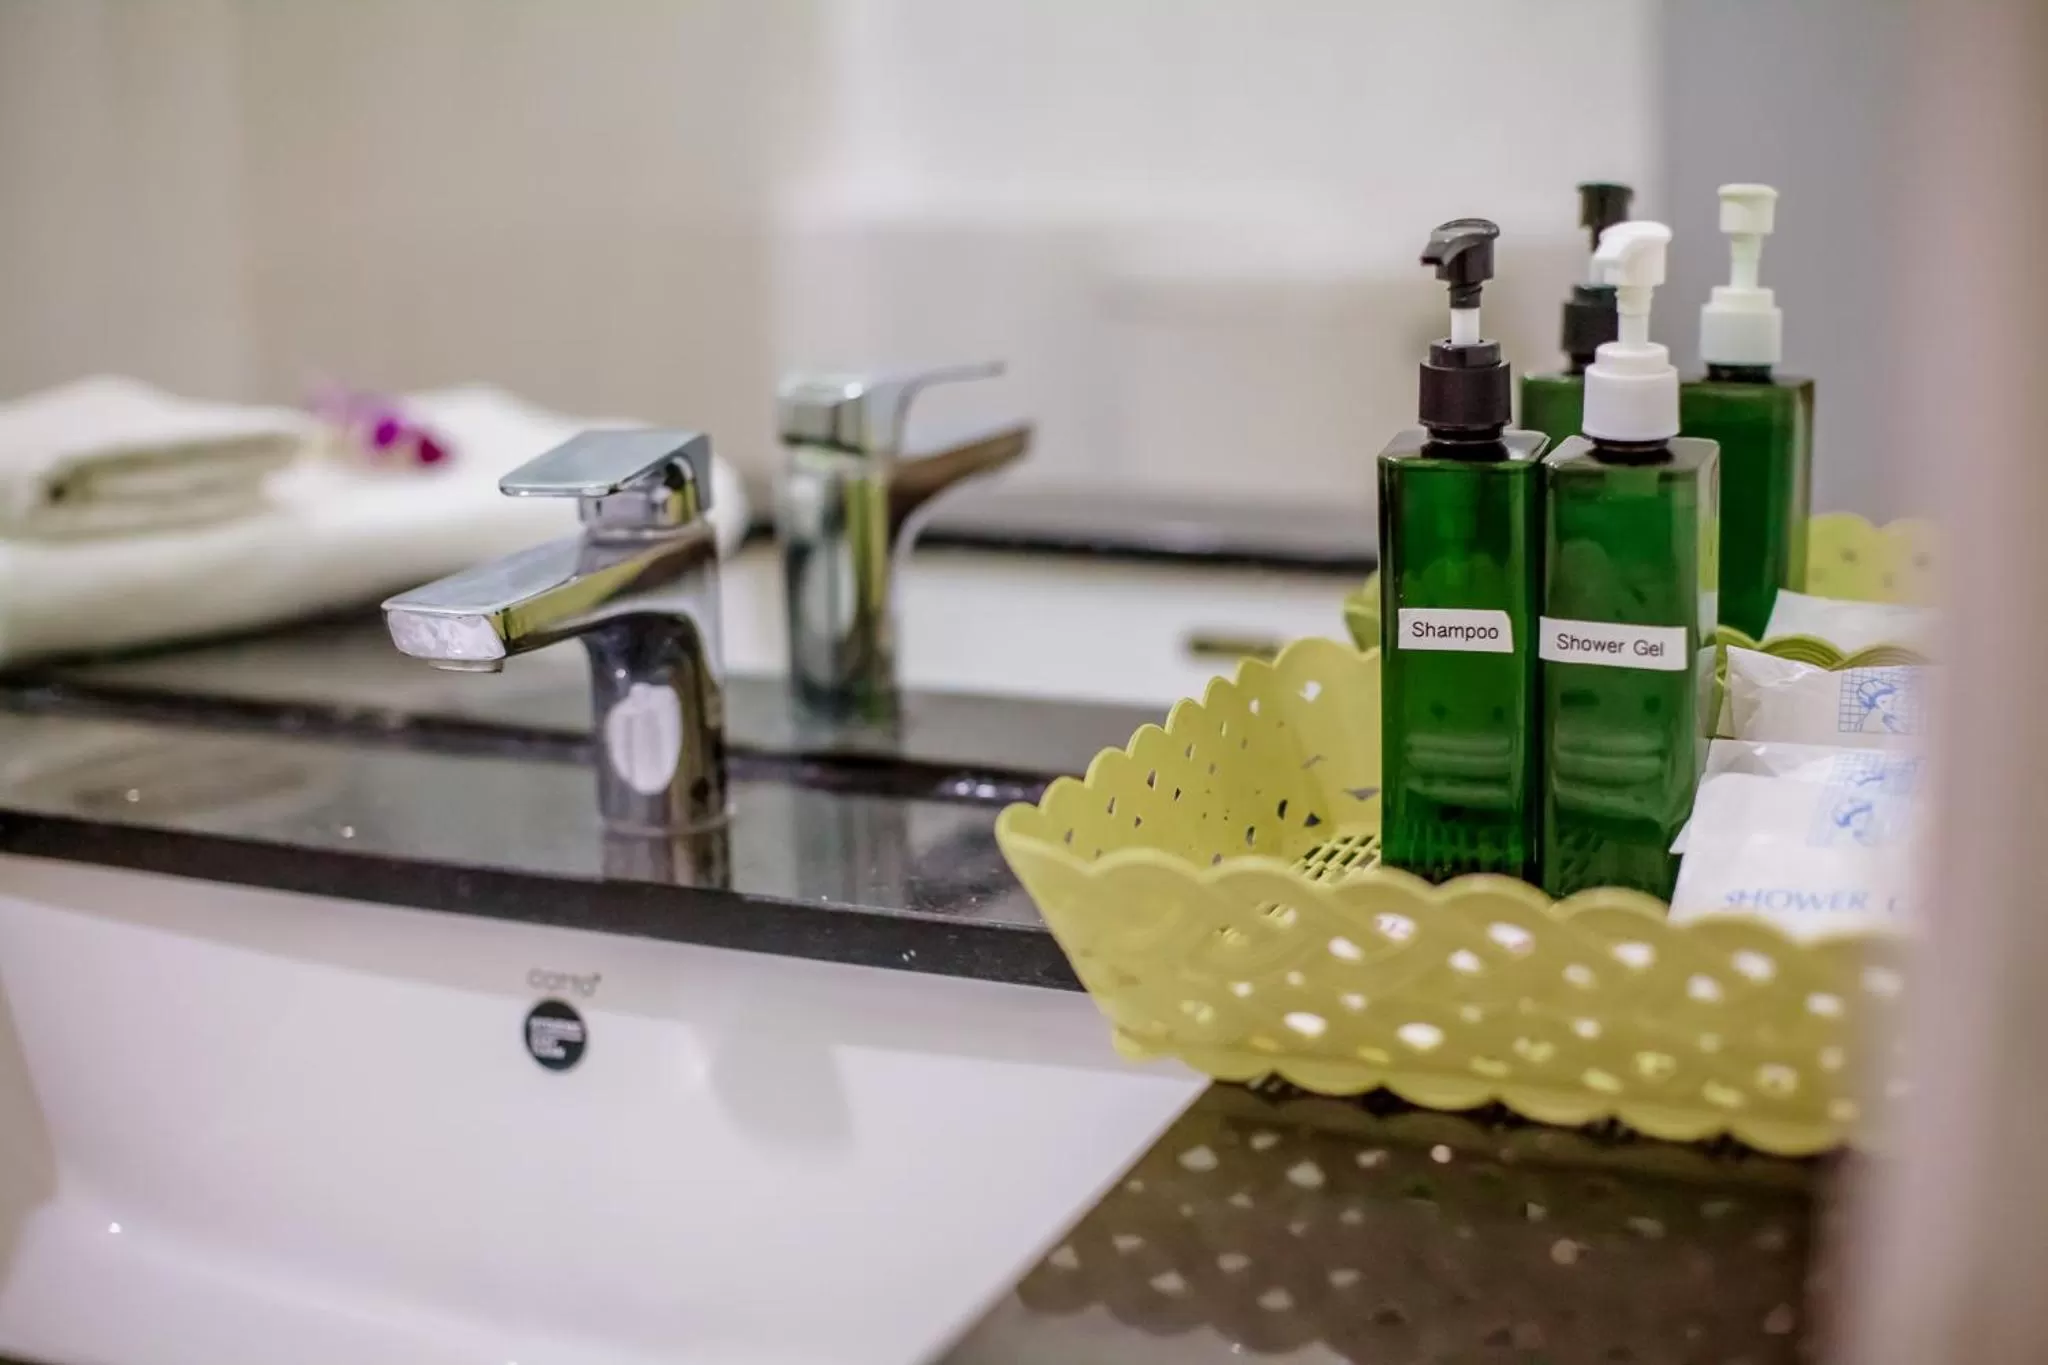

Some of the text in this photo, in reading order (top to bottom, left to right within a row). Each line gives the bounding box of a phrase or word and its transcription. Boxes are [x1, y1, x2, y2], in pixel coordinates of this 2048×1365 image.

[1411, 620, 1499, 641] Shampoo
[1556, 633, 1665, 657] Shower Gel
